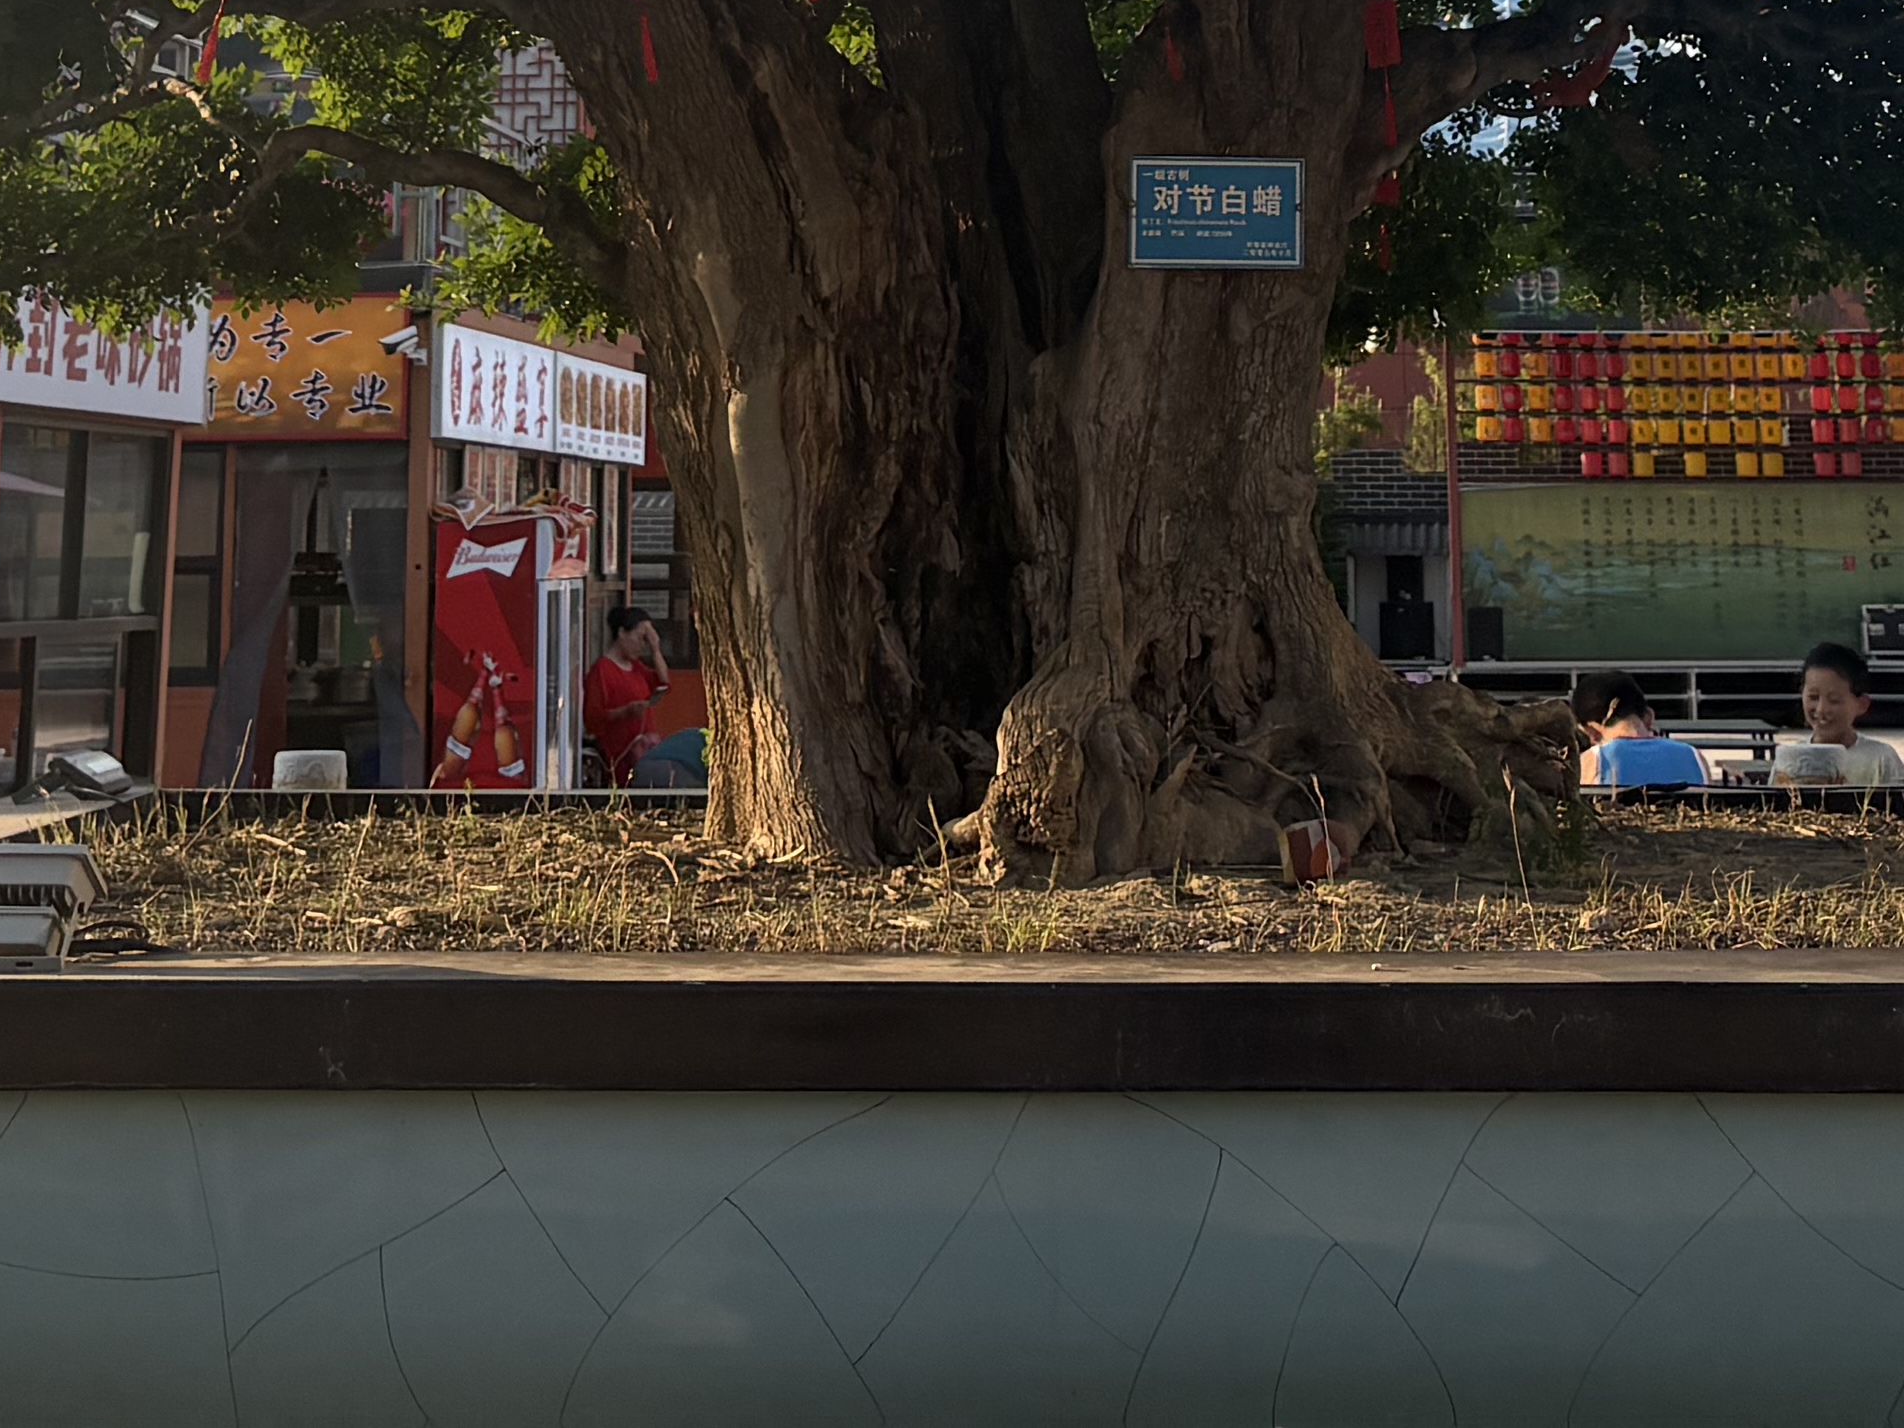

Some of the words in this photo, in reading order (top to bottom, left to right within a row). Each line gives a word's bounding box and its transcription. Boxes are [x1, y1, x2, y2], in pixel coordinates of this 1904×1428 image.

[1153, 184, 1283, 216] 对节白蜡
[456, 546, 520, 565] Budweiser
